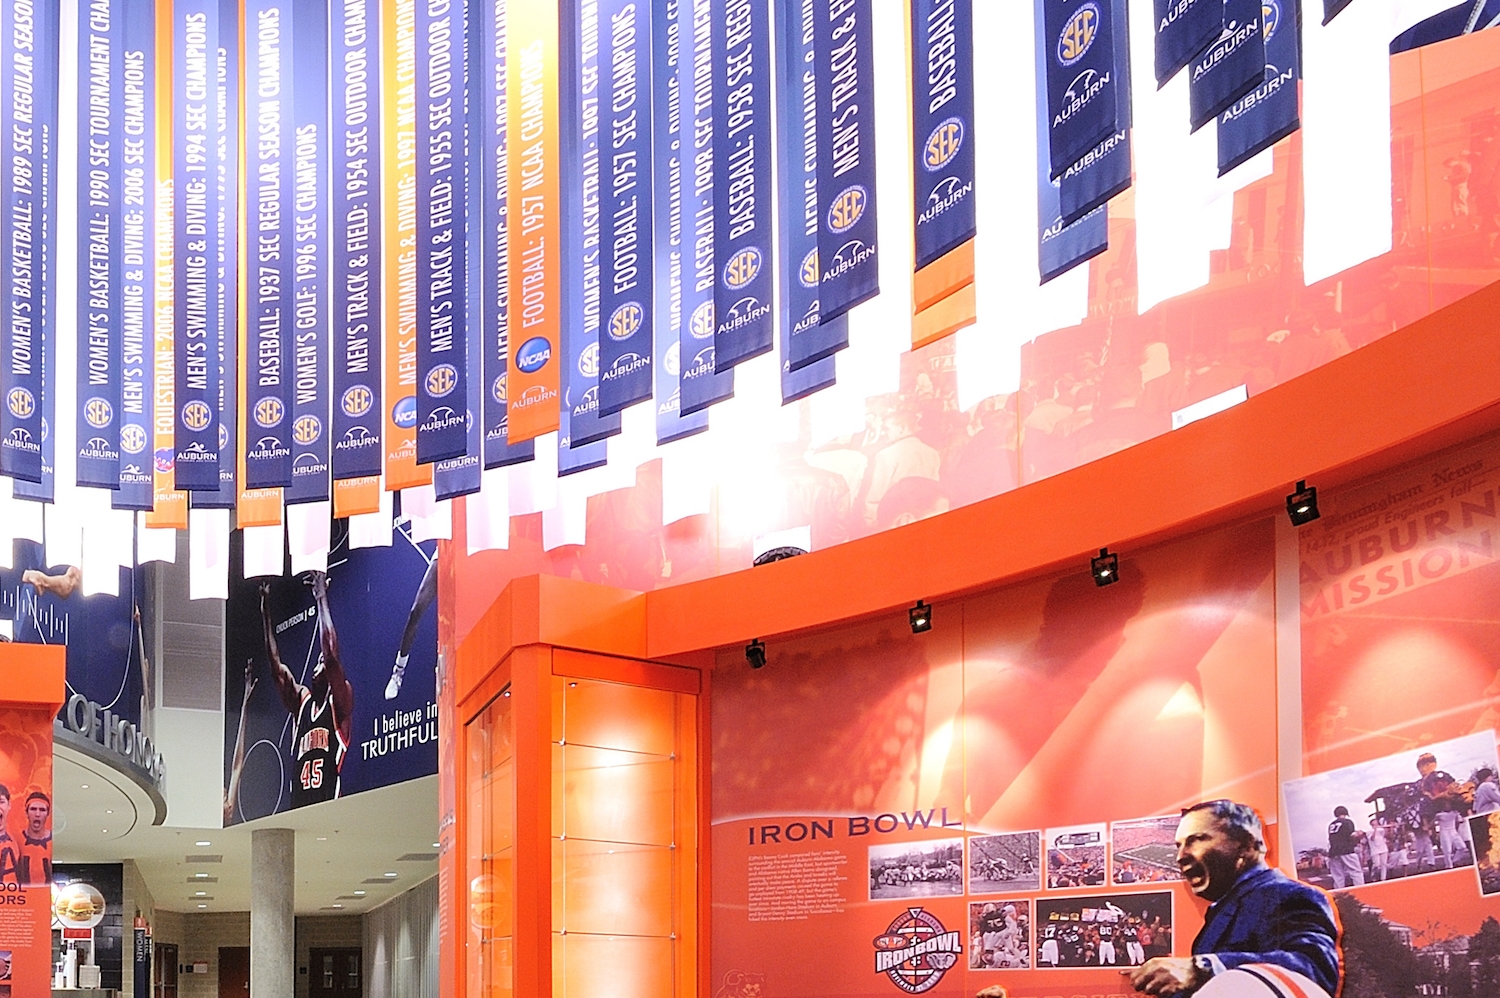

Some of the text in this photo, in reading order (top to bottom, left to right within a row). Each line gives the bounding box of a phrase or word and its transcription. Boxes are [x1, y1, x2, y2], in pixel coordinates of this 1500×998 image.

[185, 13, 206, 100] CHAMPIONS
[428, 18, 451, 96] OUTDOOR
[124, 50, 144, 135] CHAMPIONS
[831, 14, 859, 177] MEN'S TRACK &
[1222, 68, 1292, 124] AUBURN
[186, 103, 206, 131] SEC
[429, 98, 451, 131] SEC
[124, 138, 144, 165] SEC
[186, 134, 206, 172] 1994
[296, 123, 317, 211] CHAMPIONS
[430, 133, 452, 175] 1955
[612, 3, 637, 294] FOOTBALL: 1957 SEC CHAMPIONS
[124, 167, 144, 206] 2006
[258, 7, 280, 386] BASEBALL: 1937 SEC REGULAR SEASON CHAMPIONS
[520, 39, 544, 329] FOOTBALL: 1957 NCAA CHAMPIONS
[918, 181, 972, 225] AUBURN
[12, 52, 33, 375] WOMEN'S BASKETBALL: 1989 SEC REGULAR
[296, 214, 317, 241] SEC
[188, 240, 206, 251] &
[432, 230, 452, 243] &
[128, 270, 144, 281] &
[297, 243, 317, 282] 1996
[431, 249, 452, 300] TRACK
[187, 255, 206, 341] SWIMMING
[124, 285, 143, 364] SWIMMING
[431, 301, 452, 352] MEN'S
[187, 344, 206, 389] MEN'S
[296, 332, 317, 405] WOMEN'S
[519, 350, 550, 368] NCAA
[124, 367, 143, 414] MEN'S
[512, 390, 557, 409] AUBURN
[79, 449, 119, 459] AUBURN
[336, 436, 379, 450] AUBURN
[67, 693, 101, 743] OF
[374, 701, 437, 736] I believe in
[300, 759, 323, 790] 45
[748, 807, 963, 845] IRON BOWL
[1329, 822, 1342, 834] 27
